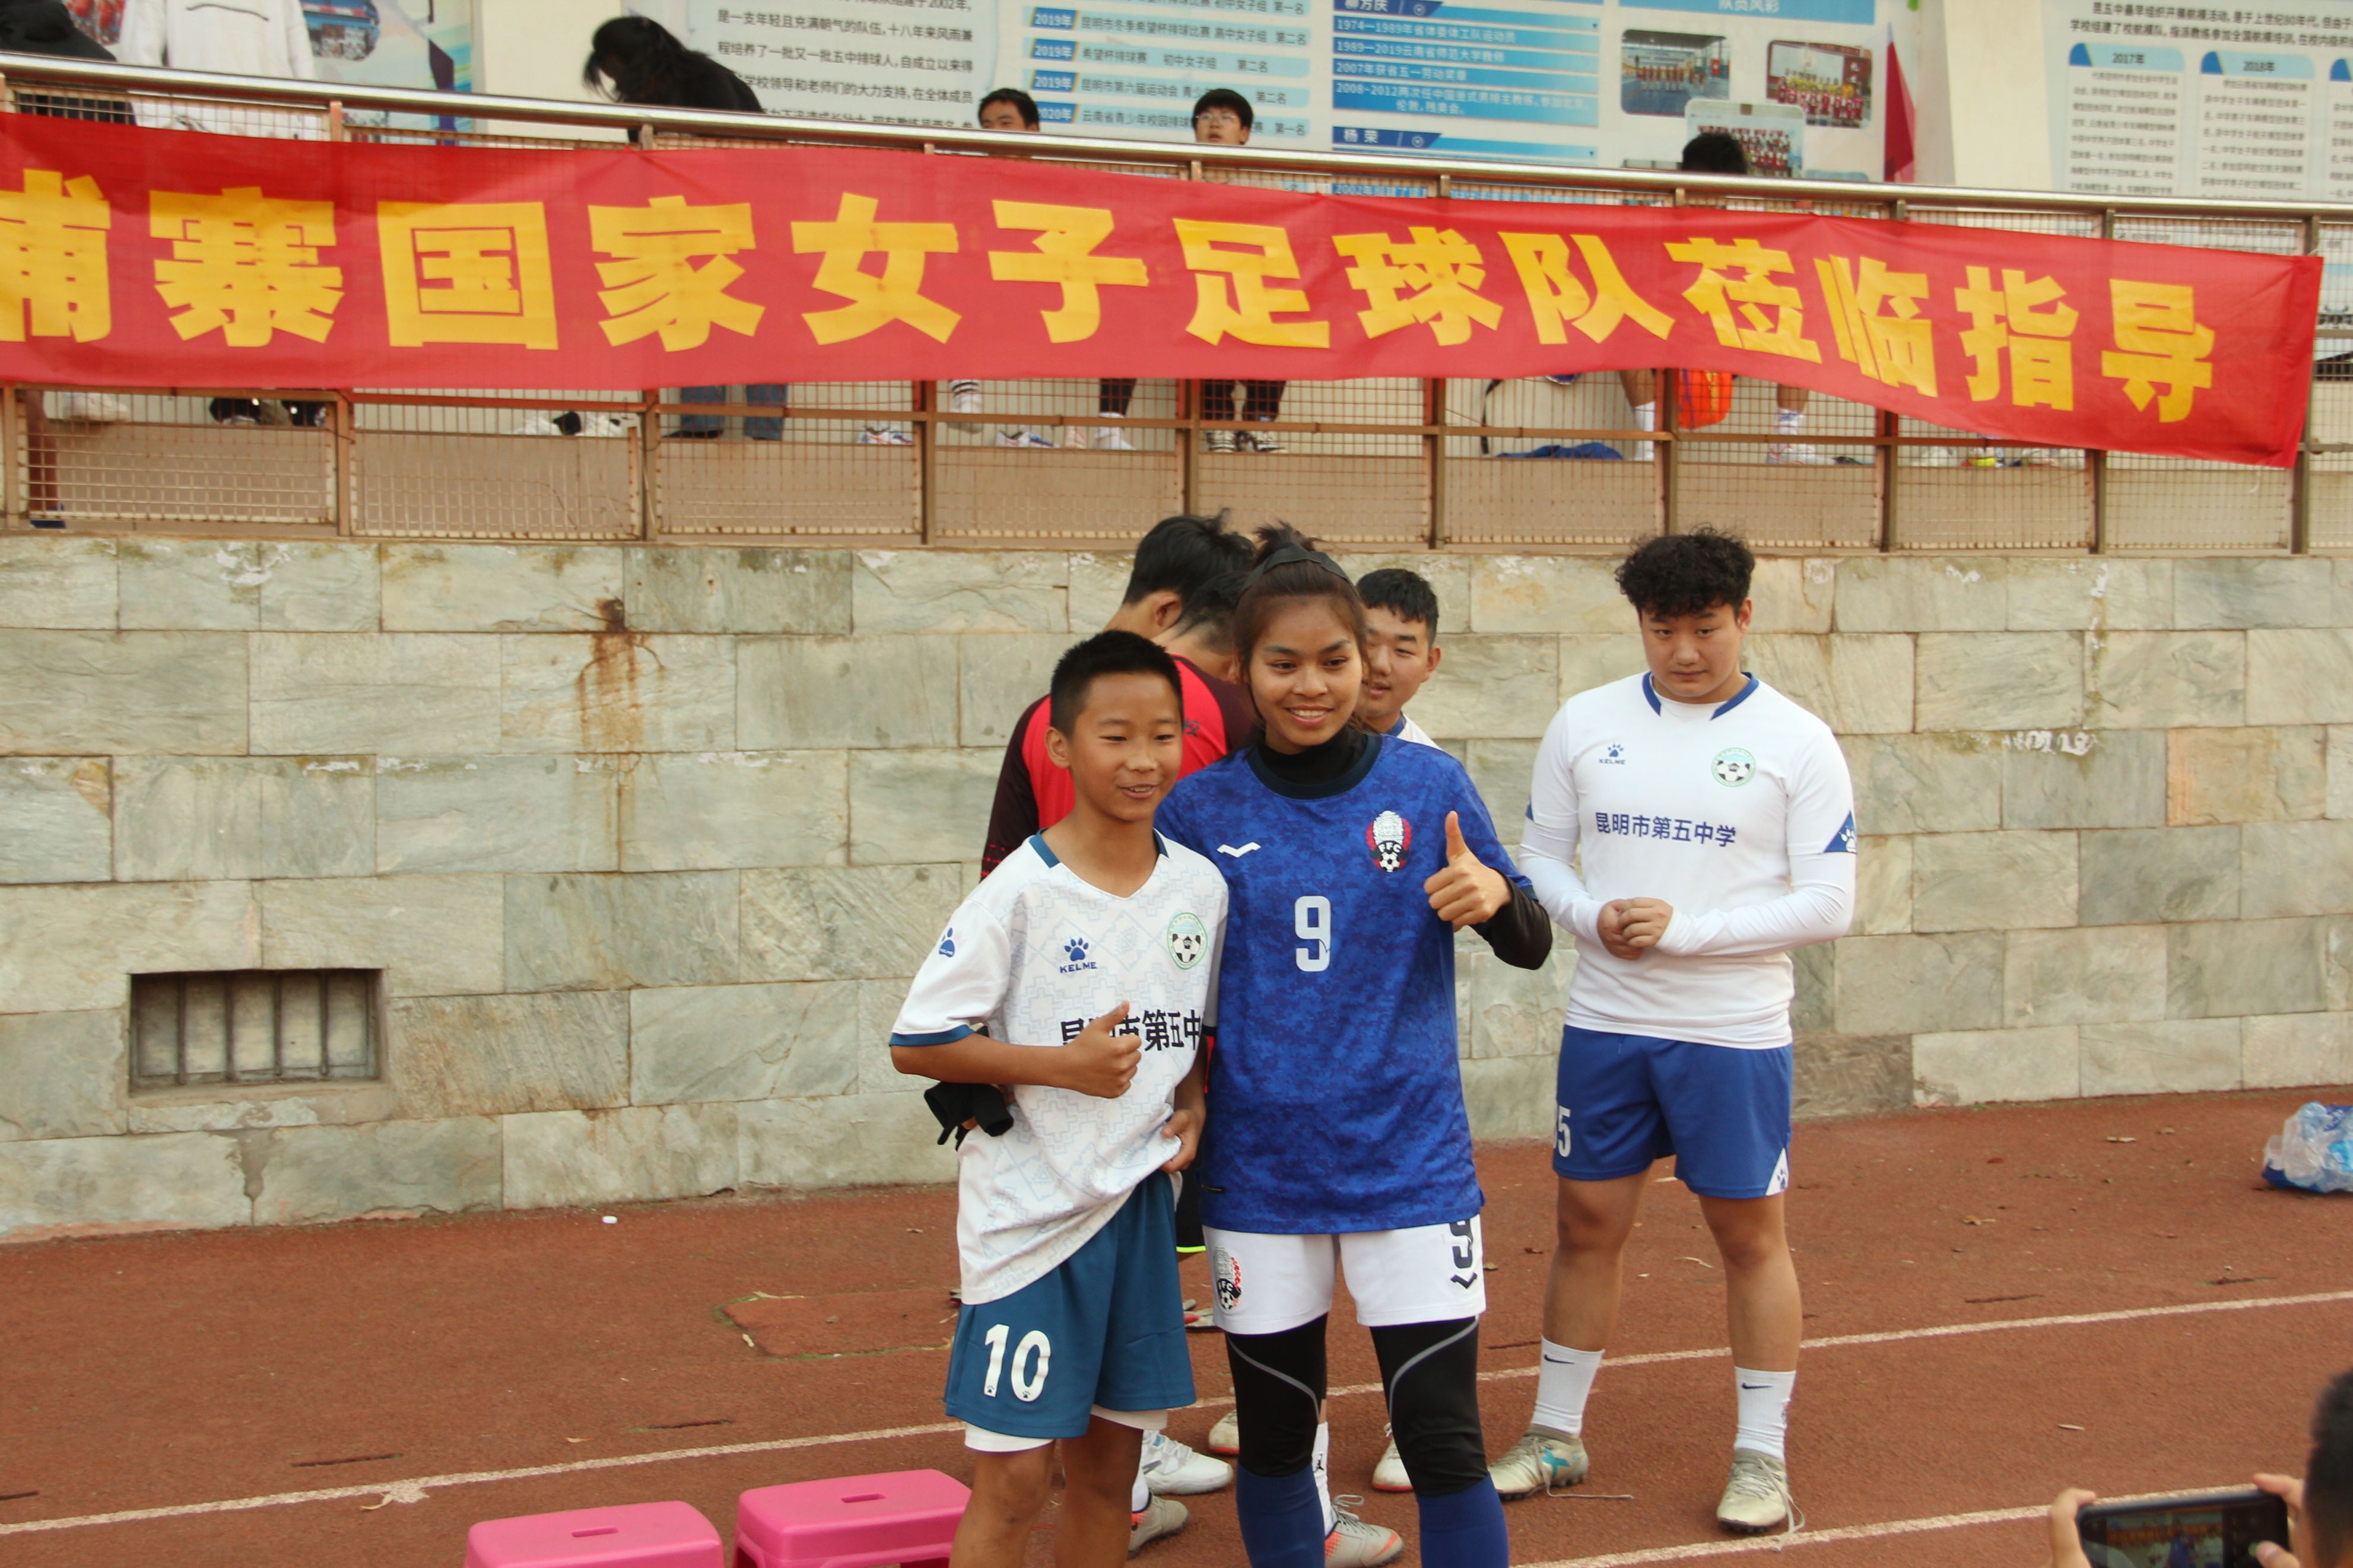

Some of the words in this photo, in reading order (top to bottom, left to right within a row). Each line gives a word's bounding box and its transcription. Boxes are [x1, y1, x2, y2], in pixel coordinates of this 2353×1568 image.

[1034, 14, 1072, 26] 2019年
[1276, 32, 1306, 46] 第二名
[1034, 45, 1072, 58] 2019年
[1238, 59, 1268, 73] 第二名
[2111, 53, 2145, 65] 2017年
[736, 73, 973, 104] 学校领导和老师们的大力支持，在全体成员
[1034, 77, 1072, 89] 2019年
[1256, 91, 1287, 105] 第二名
[1275, 123, 1305, 136] 第一名
[1595, 812, 1736, 847] 昆明市第五中学
[1378, 842, 1402, 853] FFC
[1295, 896, 1331, 972] 9
[1060, 961, 1097, 974] KELME
[983, 1324, 1051, 1402] 10
